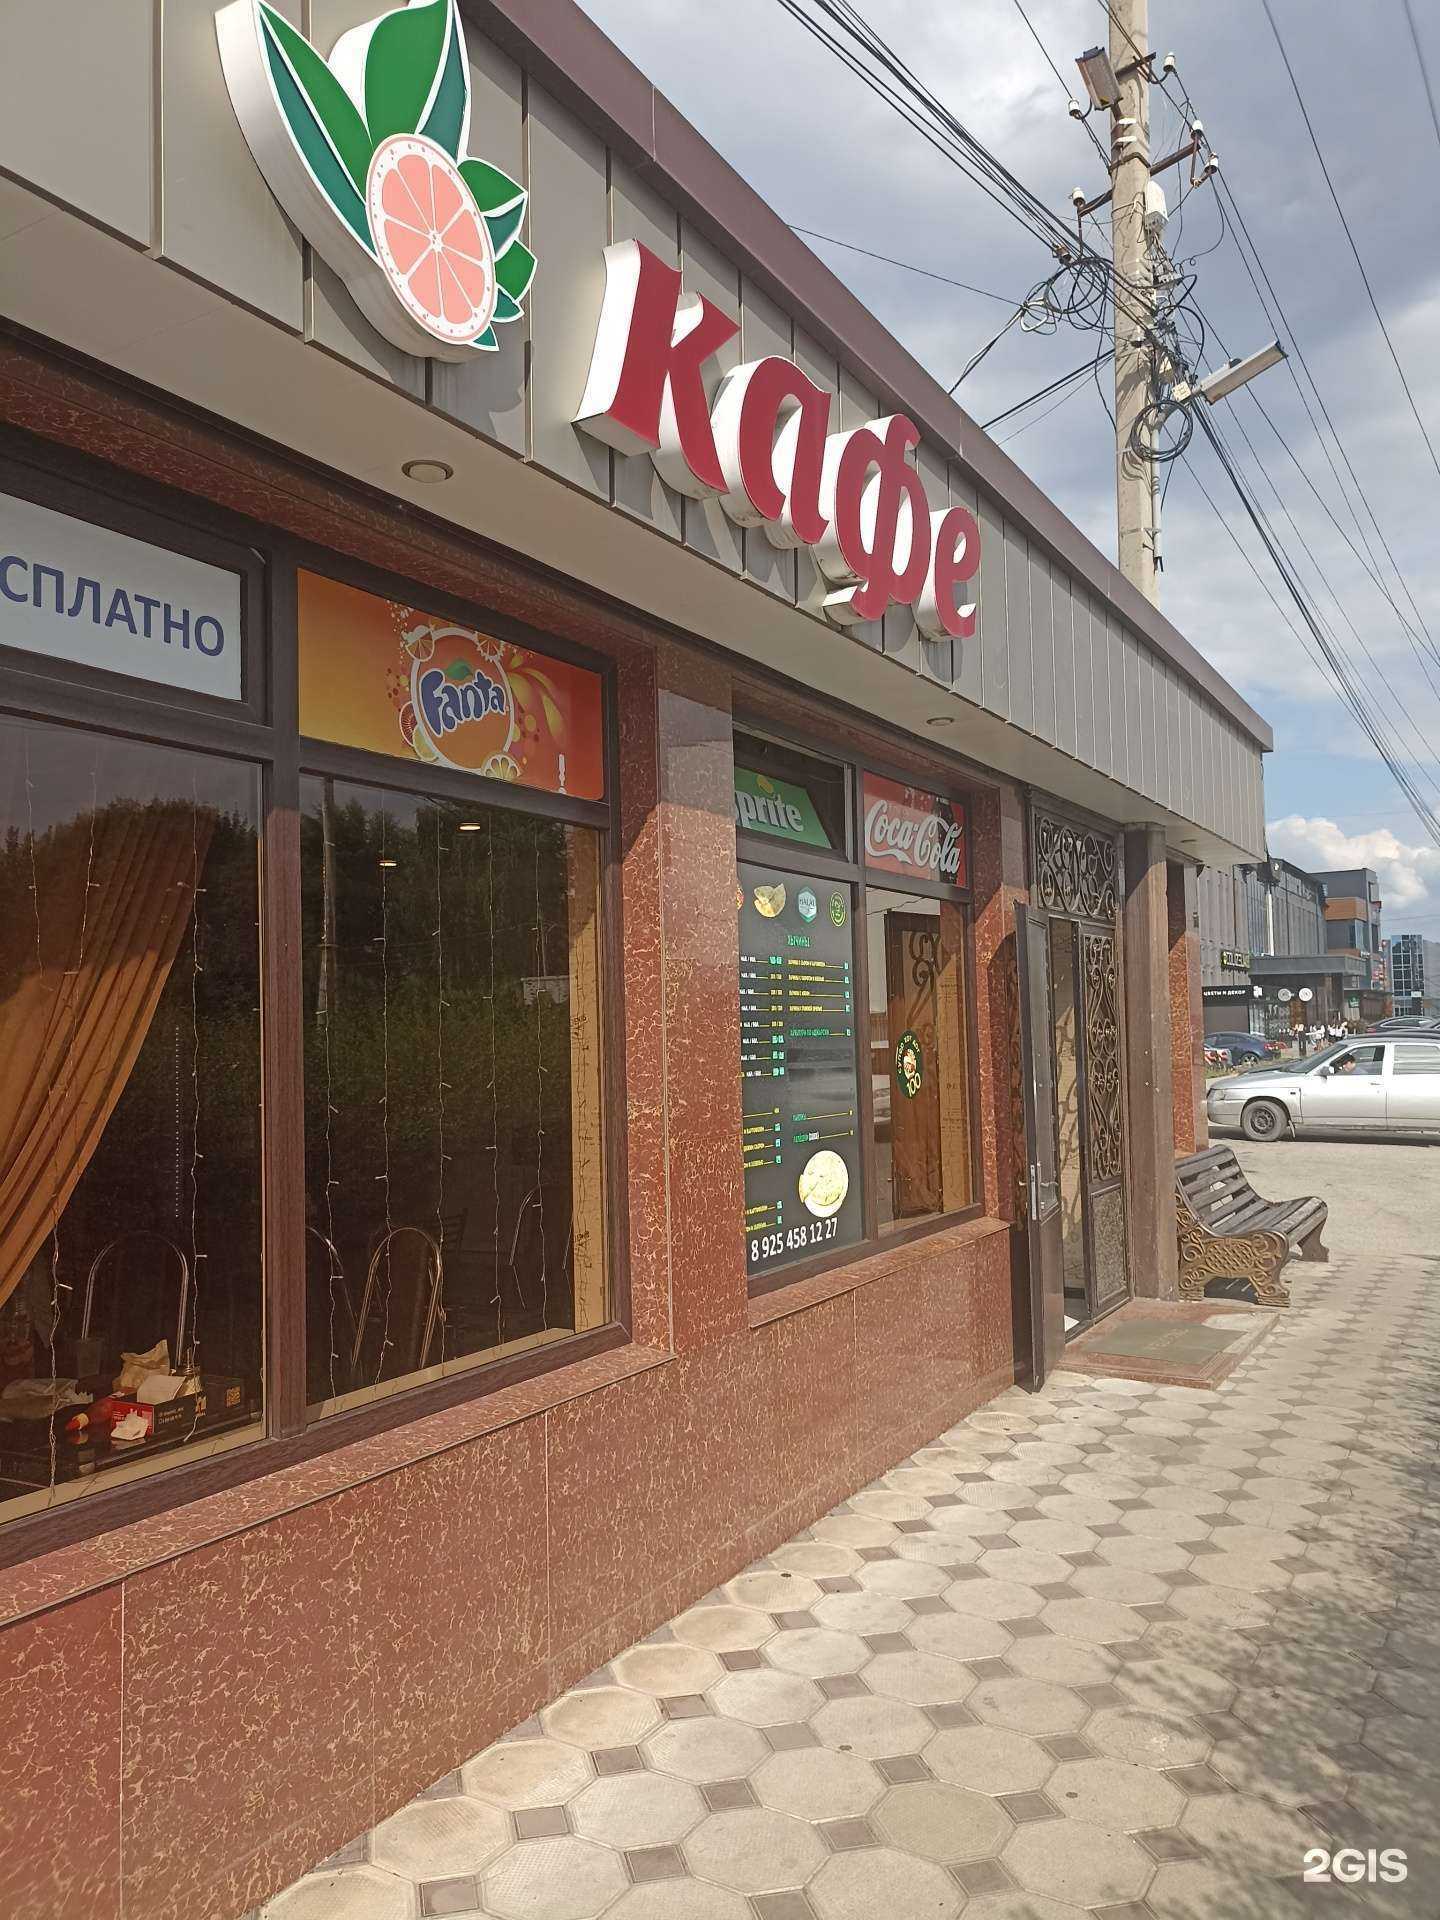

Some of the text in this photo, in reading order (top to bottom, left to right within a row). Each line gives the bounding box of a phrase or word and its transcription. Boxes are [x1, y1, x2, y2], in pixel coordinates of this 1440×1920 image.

[0, 555, 225, 657] СПЛАТНО
[419, 668, 507, 737] Fanta
[864, 799, 963, 874] Coca-Cola
[751, 1239, 759, 1262] 8
[761, 1232, 784, 1258] 925
[786, 1225, 807, 1250] 458
[810, 1221, 823, 1244] 12
[825, 1217, 838, 1239] 27
